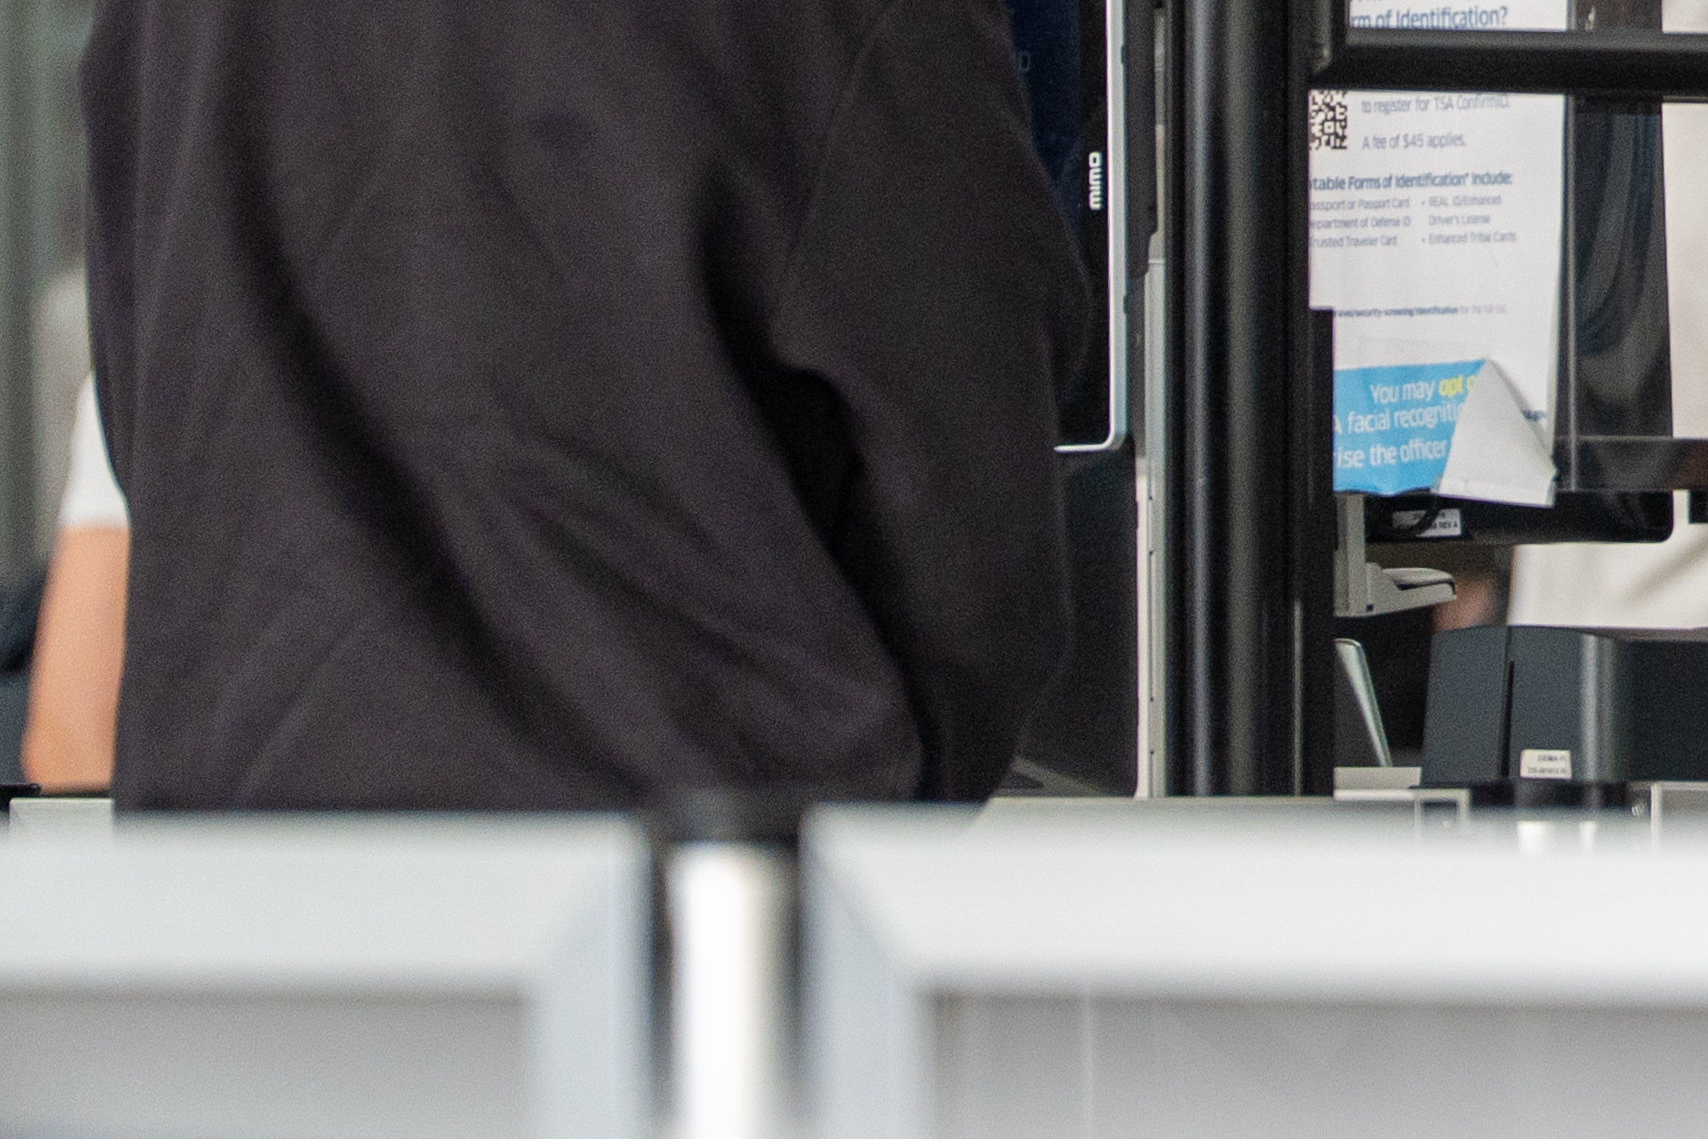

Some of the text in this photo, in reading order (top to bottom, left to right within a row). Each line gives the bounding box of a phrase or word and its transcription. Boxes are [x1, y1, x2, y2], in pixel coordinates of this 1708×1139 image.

[1375, 9, 1393, 28] of
[1396, 5, 1508, 28] Identification?
[1415, 95, 1429, 112] for
[1361, 135, 1370, 149] A
[1389, 133, 1402, 149] of
[1404, 133, 1424, 148] $45
[1348, 175, 1380, 190] Forms
[1382, 174, 1394, 189] of
[1370, 383, 1399, 404] You
[1402, 380, 1435, 402] may
[1439, 376, 1464, 399] opt
[1347, 409, 1390, 435] facial
[1369, 444, 1399, 466] the
[1400, 438, 1448, 463] officer
